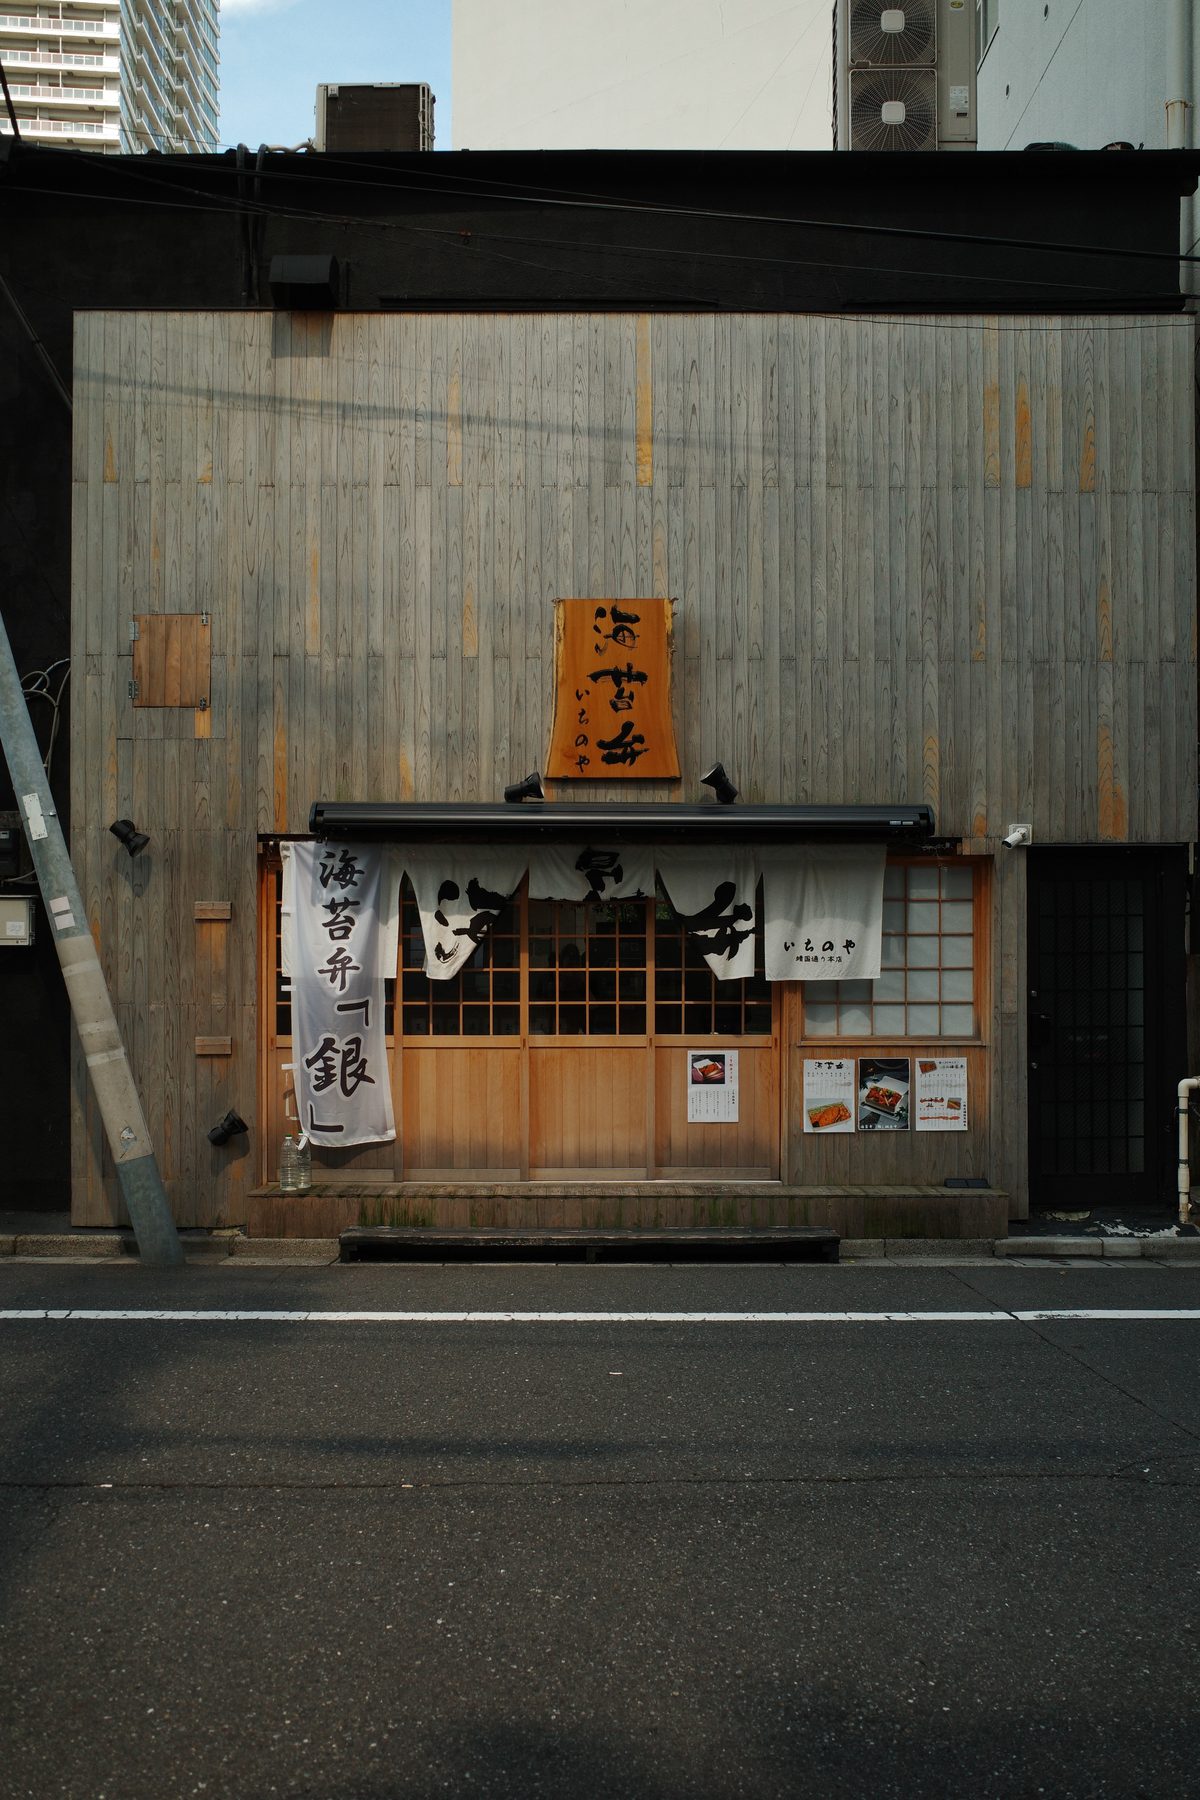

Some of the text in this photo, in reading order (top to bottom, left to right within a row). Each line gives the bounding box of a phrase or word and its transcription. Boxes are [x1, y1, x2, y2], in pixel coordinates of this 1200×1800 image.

[575, 688, 591, 773] いちのや
[587, 605, 649, 767] 海苔弁
[305, 849, 376, 1133] 海苔弁「銀」
[783, 938, 856, 955] いちのや
